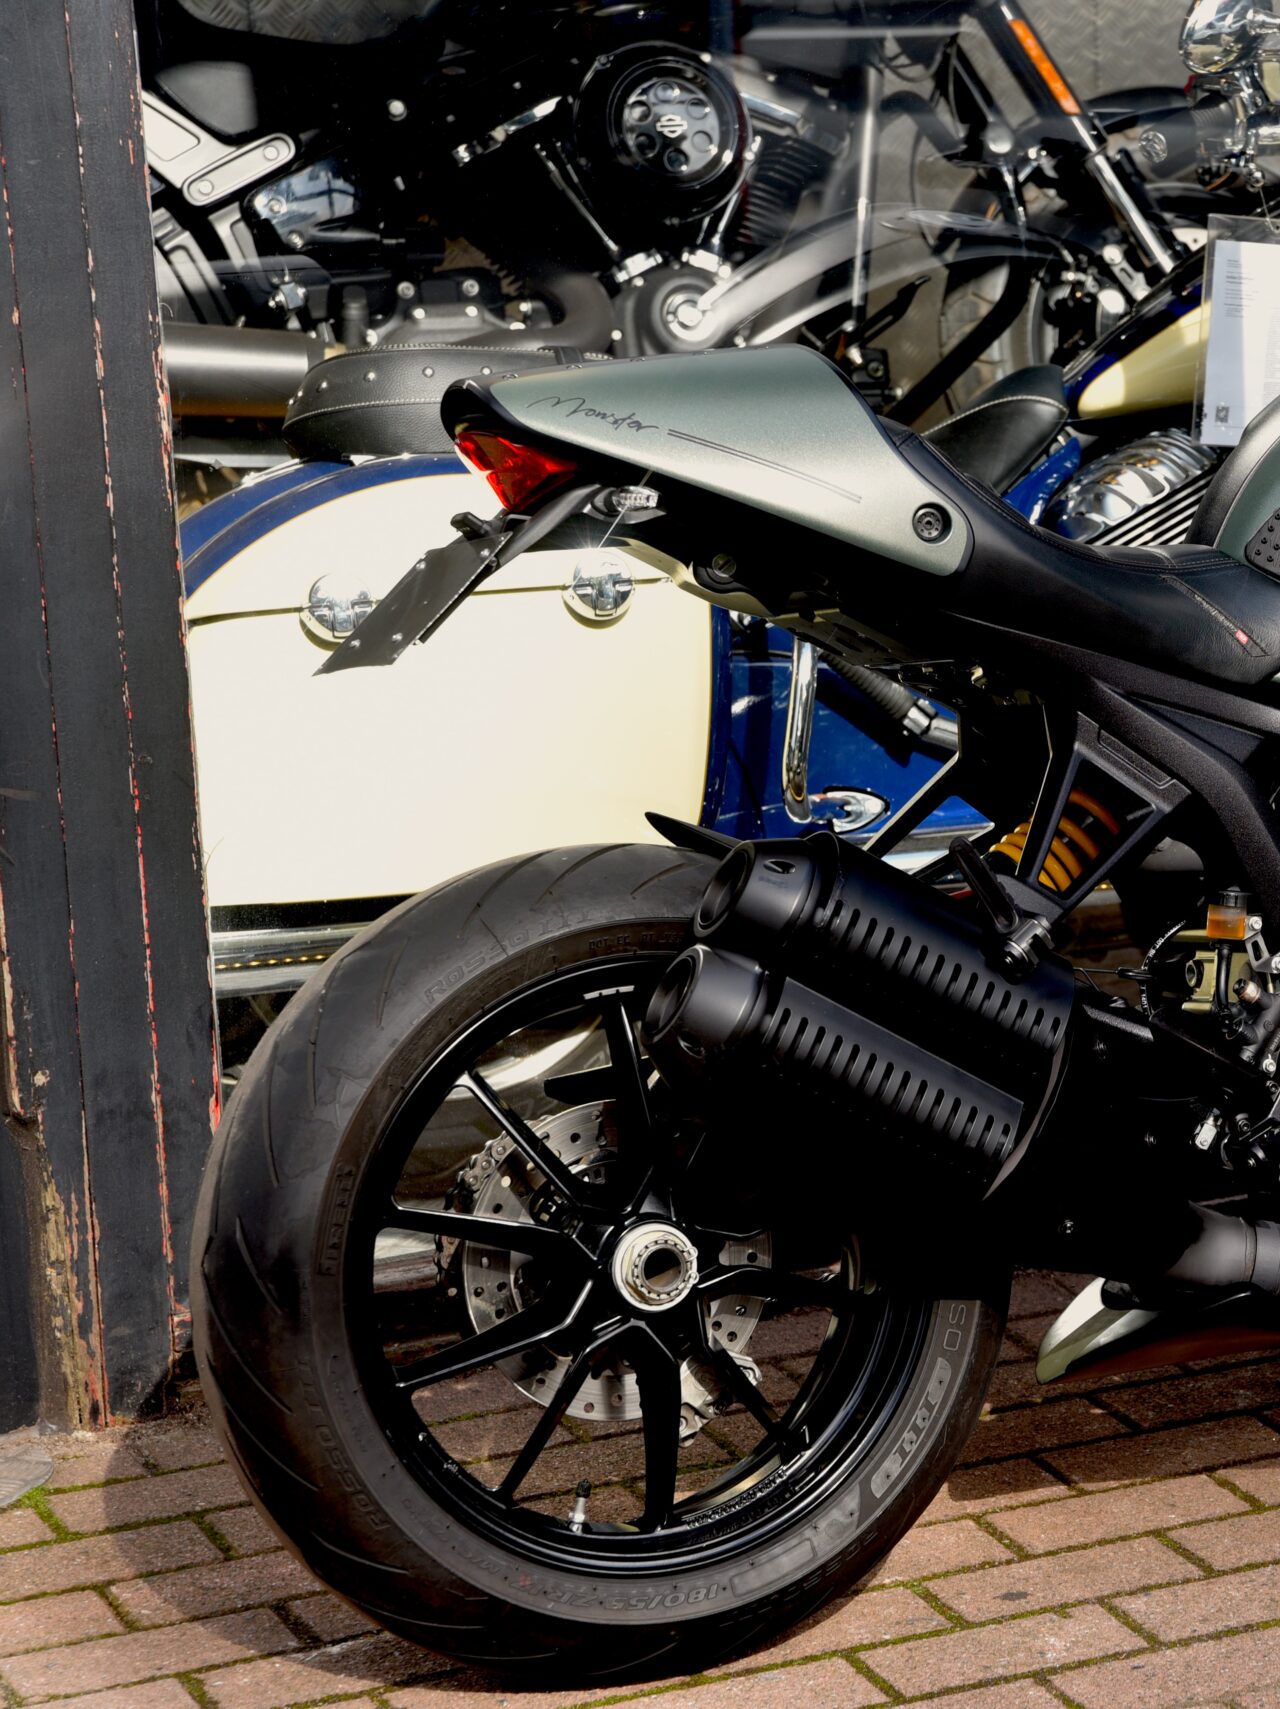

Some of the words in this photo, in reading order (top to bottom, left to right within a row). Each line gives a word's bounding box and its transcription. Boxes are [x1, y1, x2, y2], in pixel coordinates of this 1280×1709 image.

[526, 396, 659, 432] Monster
[423, 932, 530, 1002] ROSSO
[314, 1426, 391, 1533] ROSSO
[602, 1582, 720, 1611] 180/55
